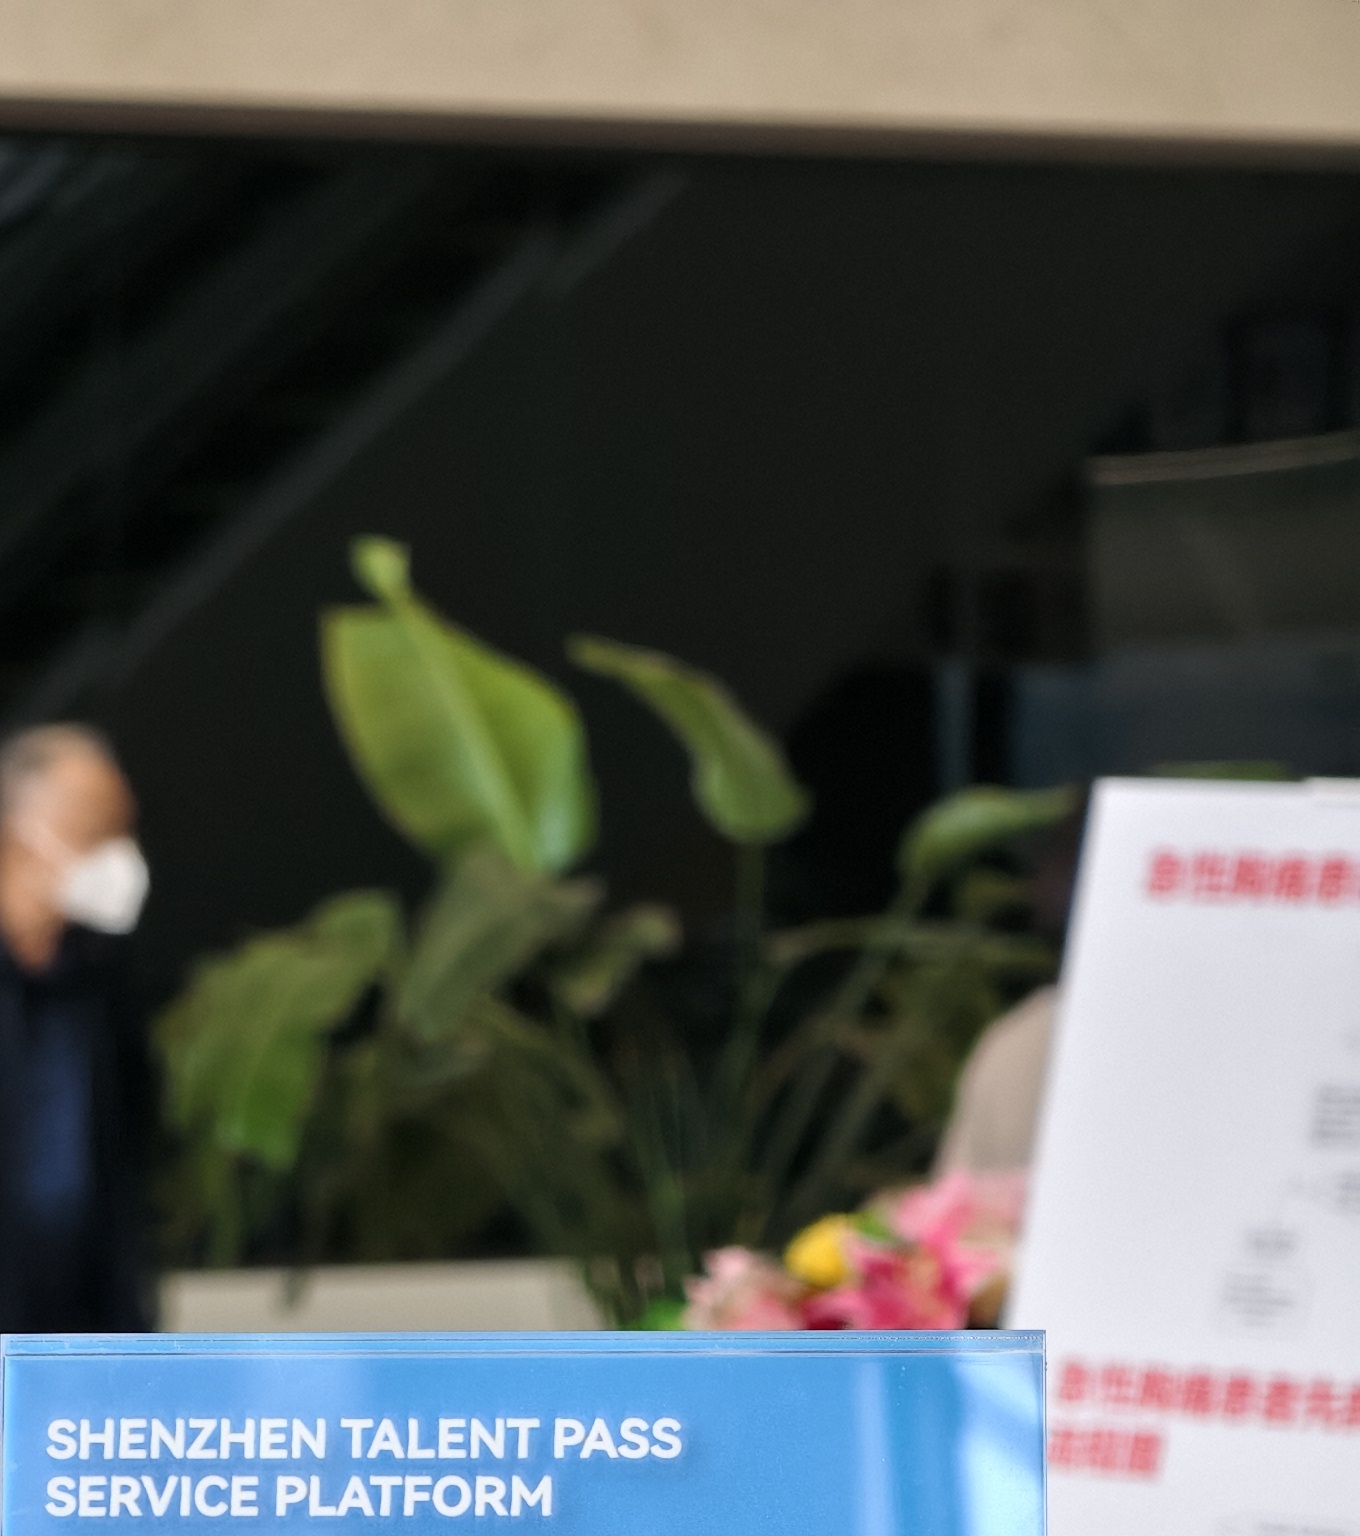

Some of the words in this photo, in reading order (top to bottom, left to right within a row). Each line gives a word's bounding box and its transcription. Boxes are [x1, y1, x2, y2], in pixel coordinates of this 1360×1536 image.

[46, 1417, 326, 1461] SHENZHEN
[340, 1417, 540, 1460] TALENT
[553, 1417, 683, 1460] PASS
[45, 1475, 259, 1518] SERVICE
[276, 1475, 553, 1518] PLATFORM
